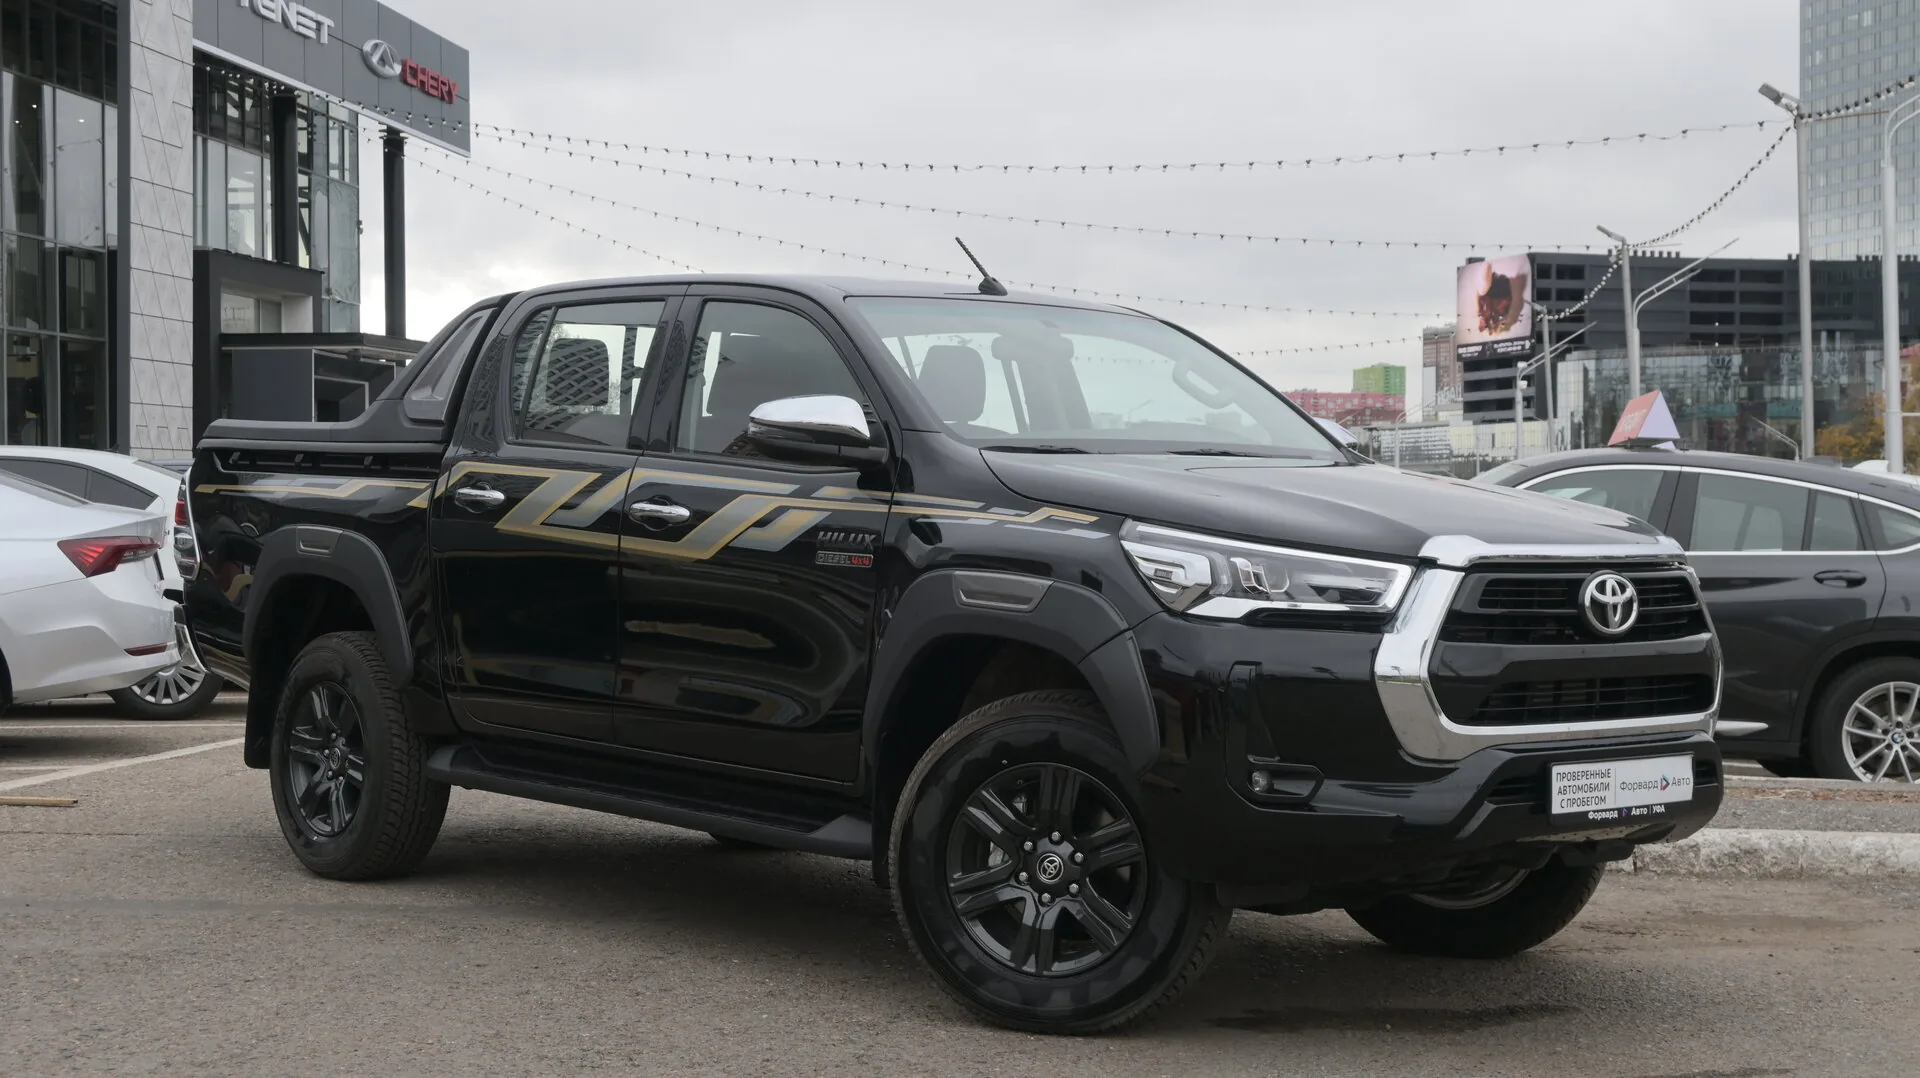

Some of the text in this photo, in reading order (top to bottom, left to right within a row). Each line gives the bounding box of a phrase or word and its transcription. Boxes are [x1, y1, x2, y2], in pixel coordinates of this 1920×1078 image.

[237, 0, 335, 44] ENET
[403, 58, 459, 104] CHERY
[817, 531, 876, 550] HILUX
[1556, 768, 1611, 783] ПРОВЕРЕННЫЕ
[1557, 782, 1610, 796] АВТОМОБИЛИ
[1619, 776, 1691, 793] Форвард Авто
[1560, 796, 1607, 809] С ПРОБЕГОМ
[1588, 804, 1666, 821] Форвард Авто УФА
